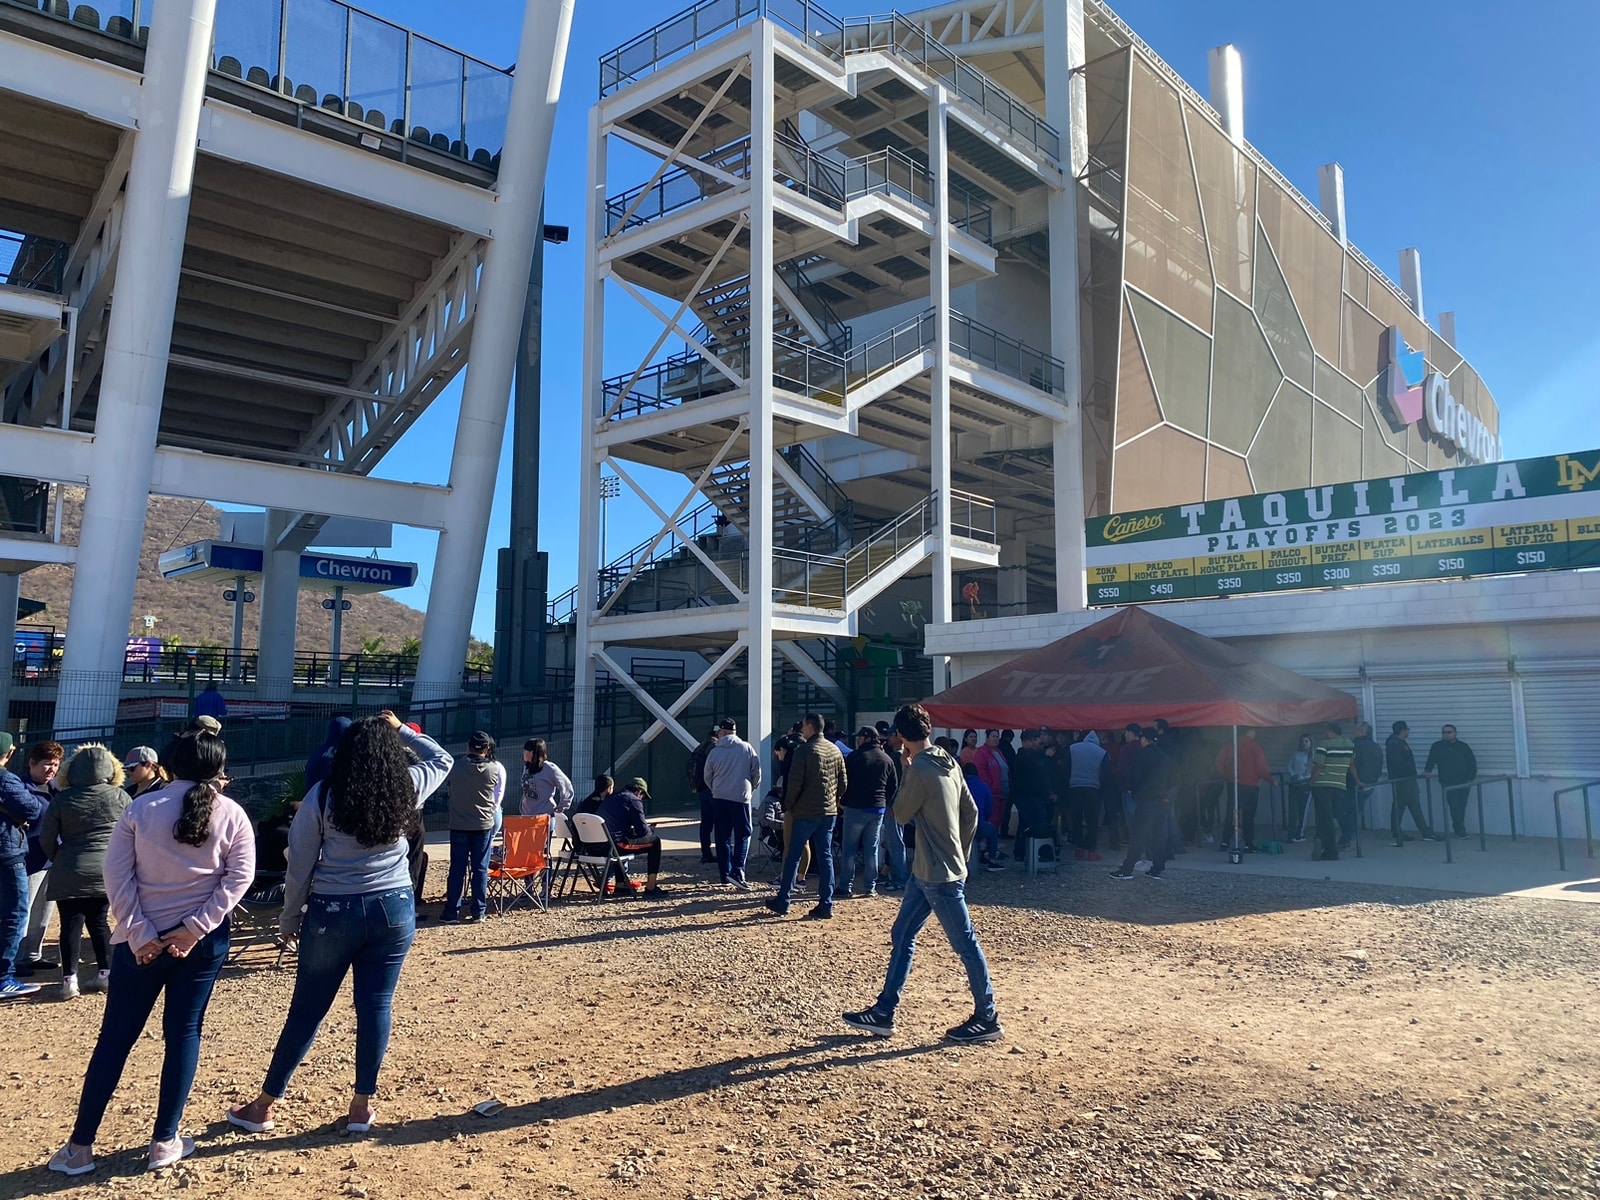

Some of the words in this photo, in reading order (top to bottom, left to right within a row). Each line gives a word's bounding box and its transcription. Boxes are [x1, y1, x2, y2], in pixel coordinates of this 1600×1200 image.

[1180, 463, 1526, 535] TAQUILLA
[1103, 513, 1163, 543] Cañeros
[1207, 520, 1361, 552] PLAYOFFS
[1384, 509, 1465, 534] 2023
[1501, 523, 1557, 537] LATERAL
[1364, 538, 1406, 550] PLATEA
[1417, 535, 1484, 550] LATERALES
[1271, 549, 1301, 560] PALCO
[1315, 543, 1355, 555] BUTACA
[1373, 548, 1398, 559] SUP.
[1208, 554, 1245, 566] BUTACA
[1268, 556, 1307, 568] DUGOUT
[1321, 552, 1351, 563] PREF.
[1517, 550, 1546, 565] $150
[1146, 562, 1173, 571] PALCO
[1200, 565, 1225, 574] HOME
[1228, 561, 1258, 572] PLATE
[1372, 563, 1400, 577] $350
[1438, 557, 1465, 571] $150
[316, 560, 392, 581] Chevron
[1096, 566, 1118, 576] ZONA
[1135, 571, 1159, 580] HOME
[1160, 568, 1189, 578] PLATE
[1323, 568, 1350, 580] $300
[1101, 575, 1116, 583] VIP
[1218, 577, 1242, 589] $350
[1276, 572, 1301, 584] $350
[1098, 587, 1120, 598] $550
[1150, 584, 1173, 595] $450
[1001, 665, 1167, 698] TECATE
